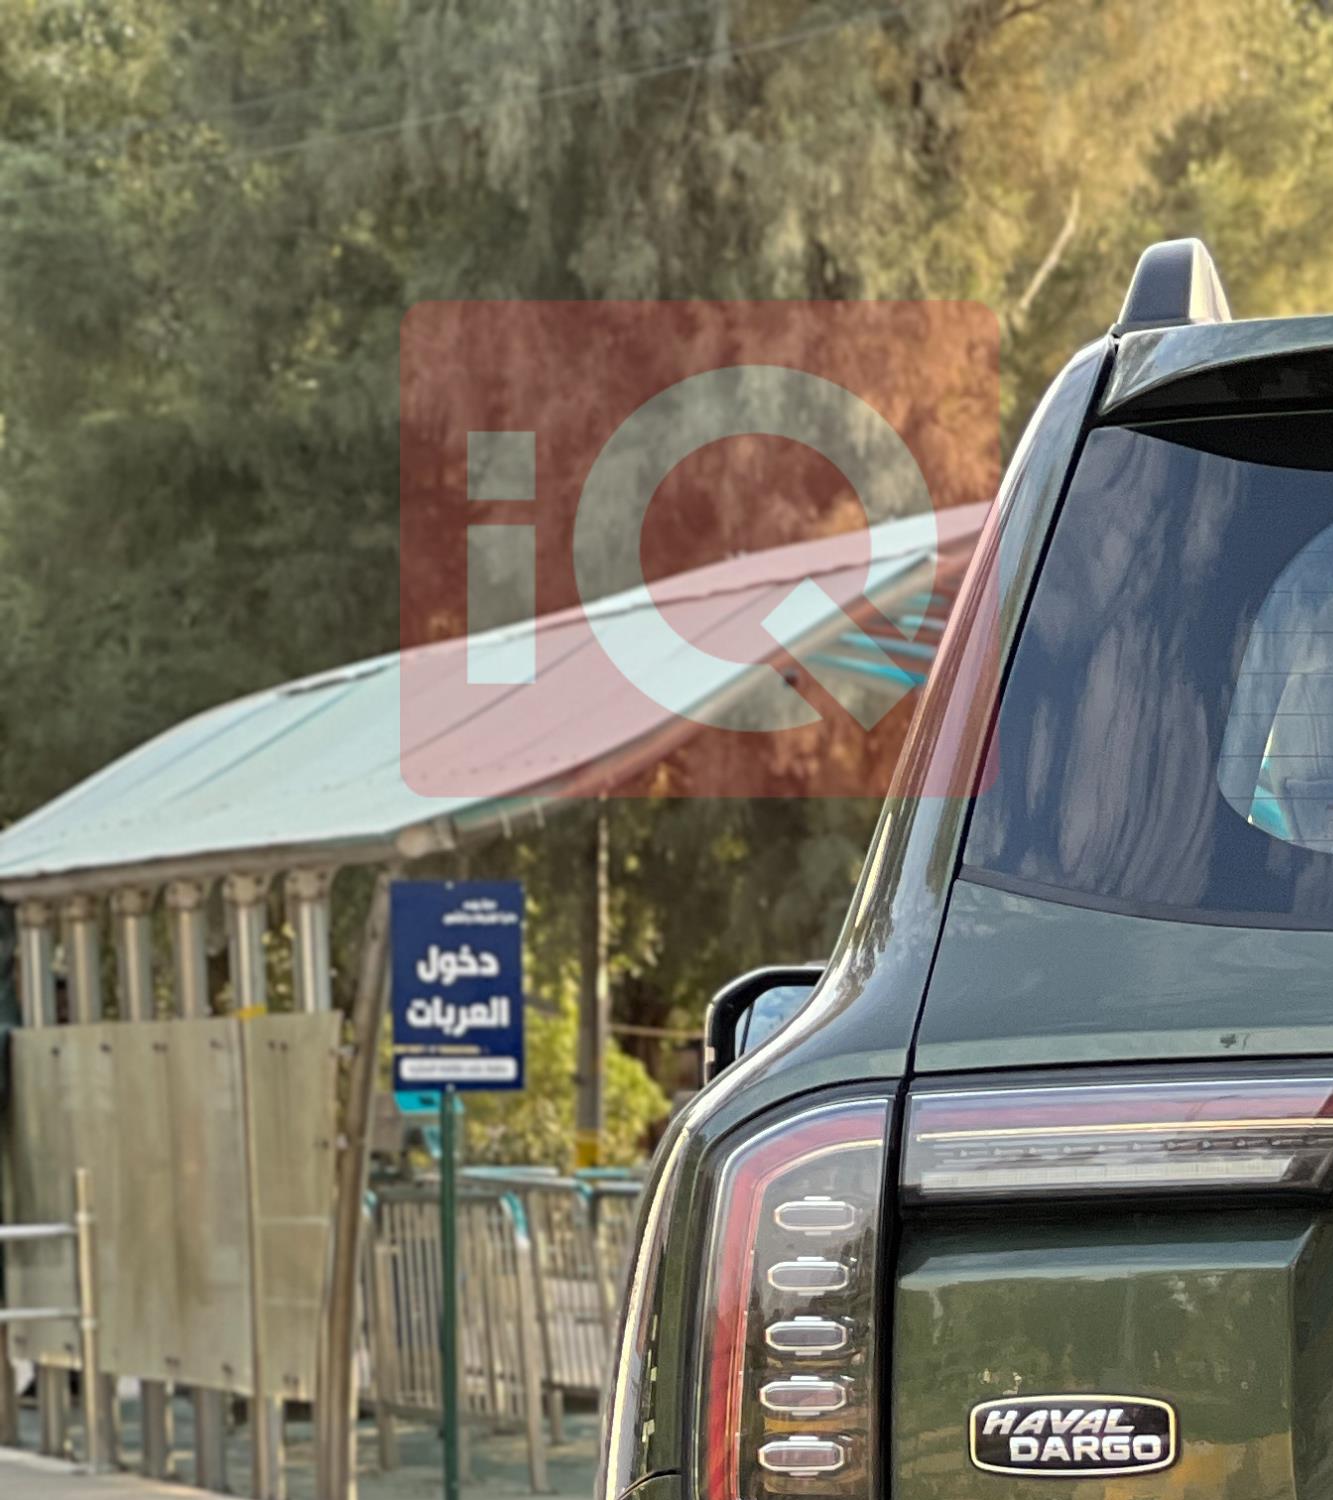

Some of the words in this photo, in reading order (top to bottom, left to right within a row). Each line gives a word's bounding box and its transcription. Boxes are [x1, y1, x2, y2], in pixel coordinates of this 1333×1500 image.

[416, 944, 500, 985] دخول
[405, 996, 510, 1037] العربات
[982, 1408, 1135, 1435] HAVAL
[1009, 1434, 1161, 1462] DARGO
